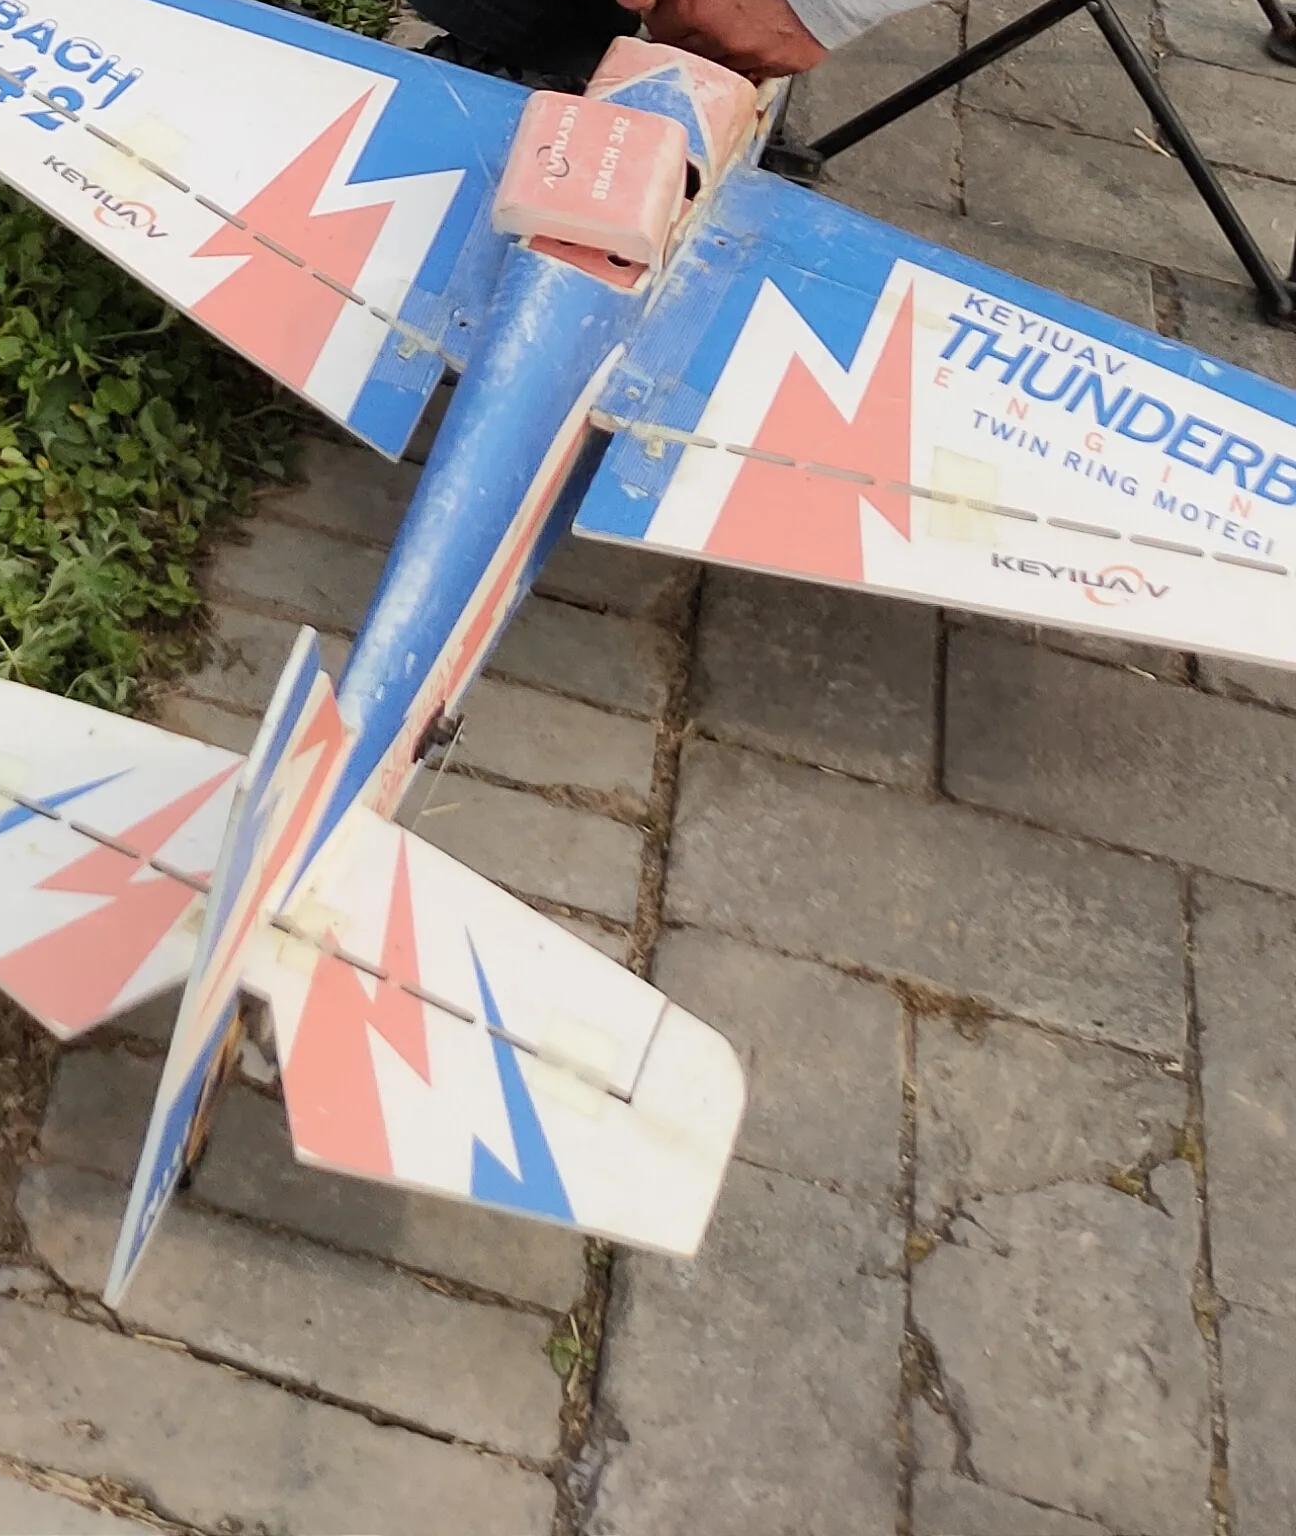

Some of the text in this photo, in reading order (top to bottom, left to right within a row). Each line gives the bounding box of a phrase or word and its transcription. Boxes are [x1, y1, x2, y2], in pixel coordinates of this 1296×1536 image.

[591, 116, 632, 201] SBACH 342
[963, 293, 1127, 376] KEYIUAV
[973, 409, 1275, 556] TWIN RING MOTEGI
